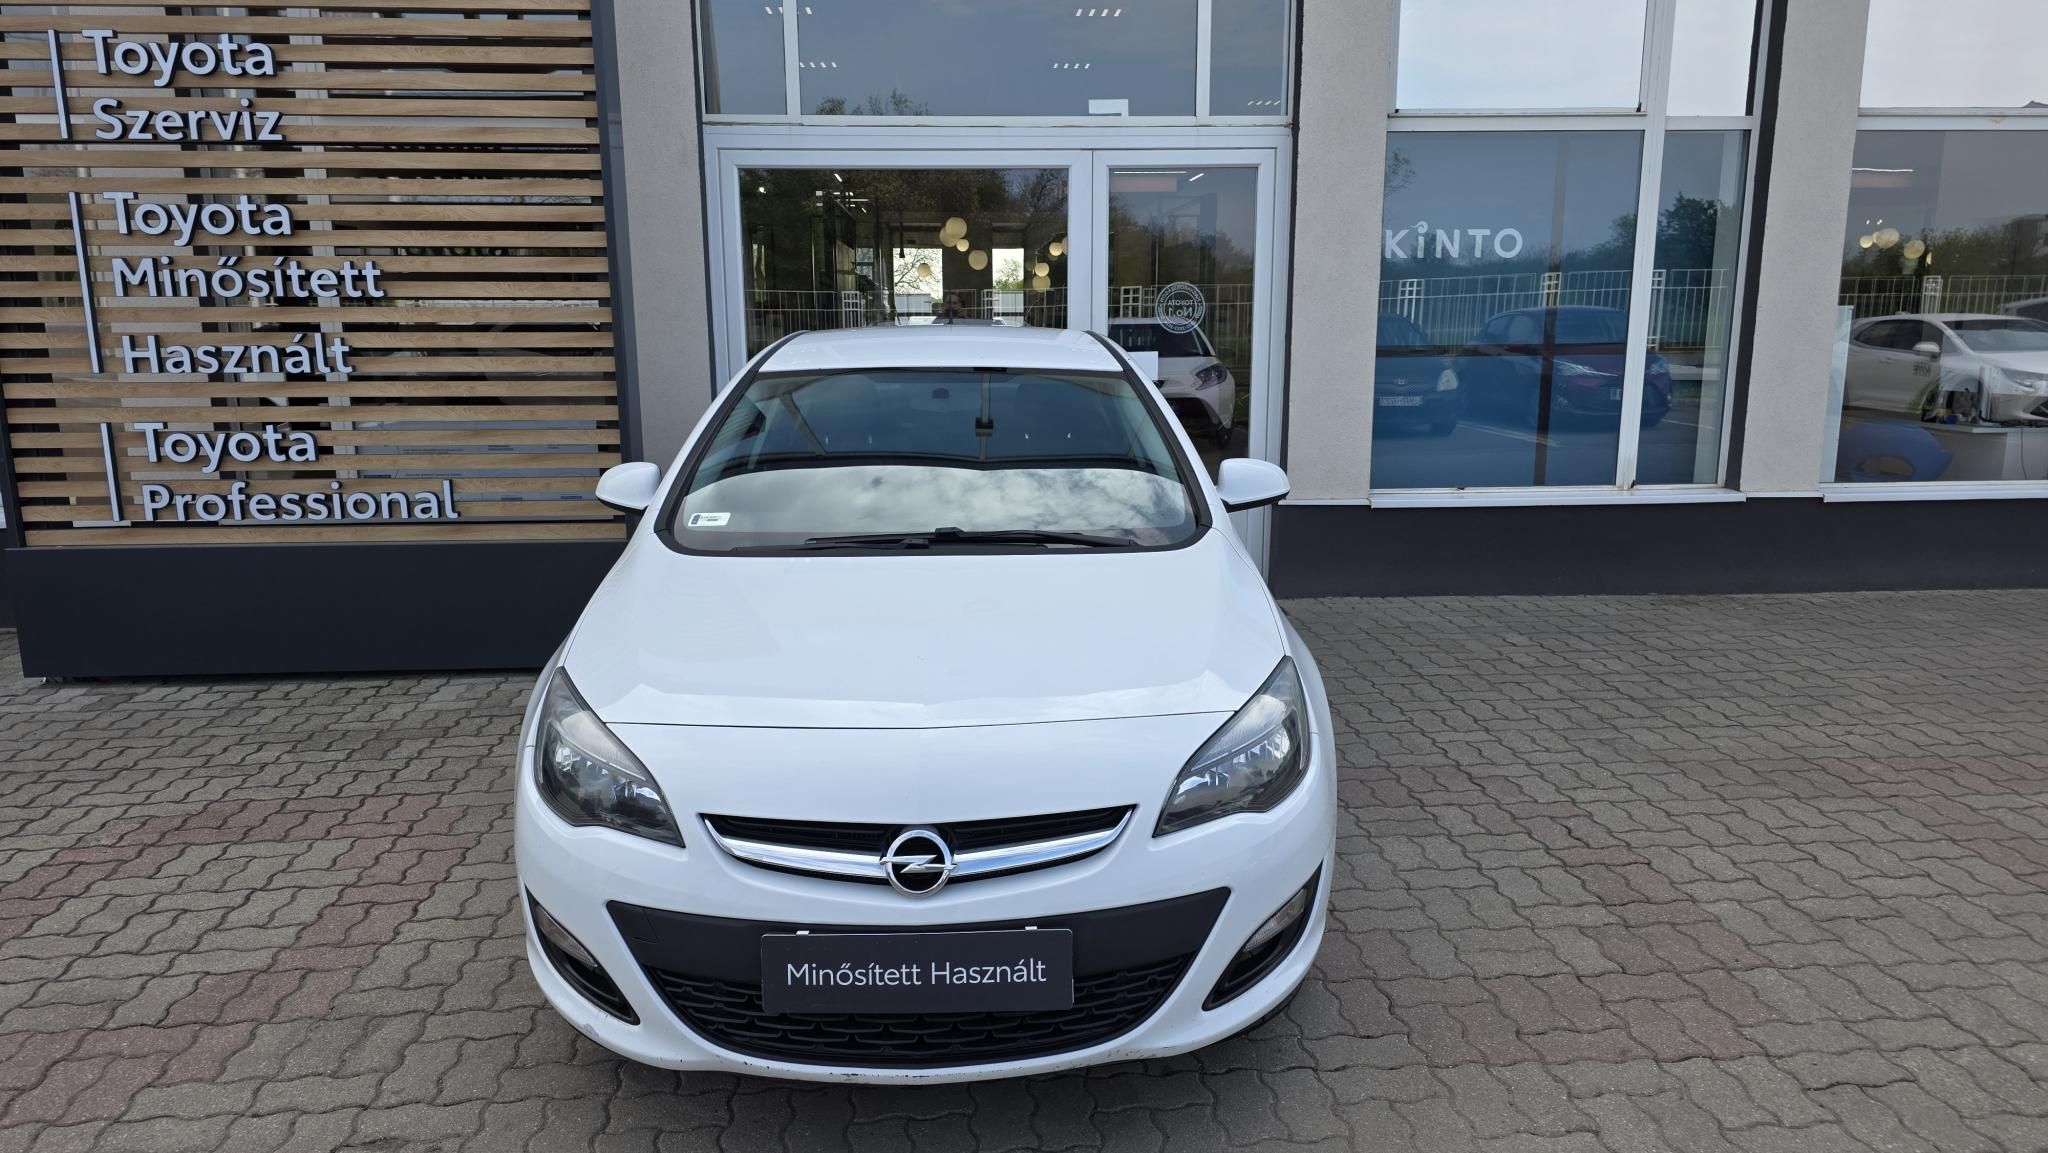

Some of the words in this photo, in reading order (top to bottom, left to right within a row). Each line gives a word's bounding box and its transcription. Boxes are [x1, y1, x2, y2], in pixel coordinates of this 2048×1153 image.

[82, 29, 275, 86] Toyota
[93, 98, 284, 141] Szerviz
[103, 191, 292, 246] Toyota
[112, 256, 385, 298] Minősített
[122, 332, 353, 374] Használt
[133, 422, 317, 473] Toyota
[142, 480, 460, 521] Professional
[787, 962, 922, 986] Minősített
[931, 957, 1047, 985] Használt
